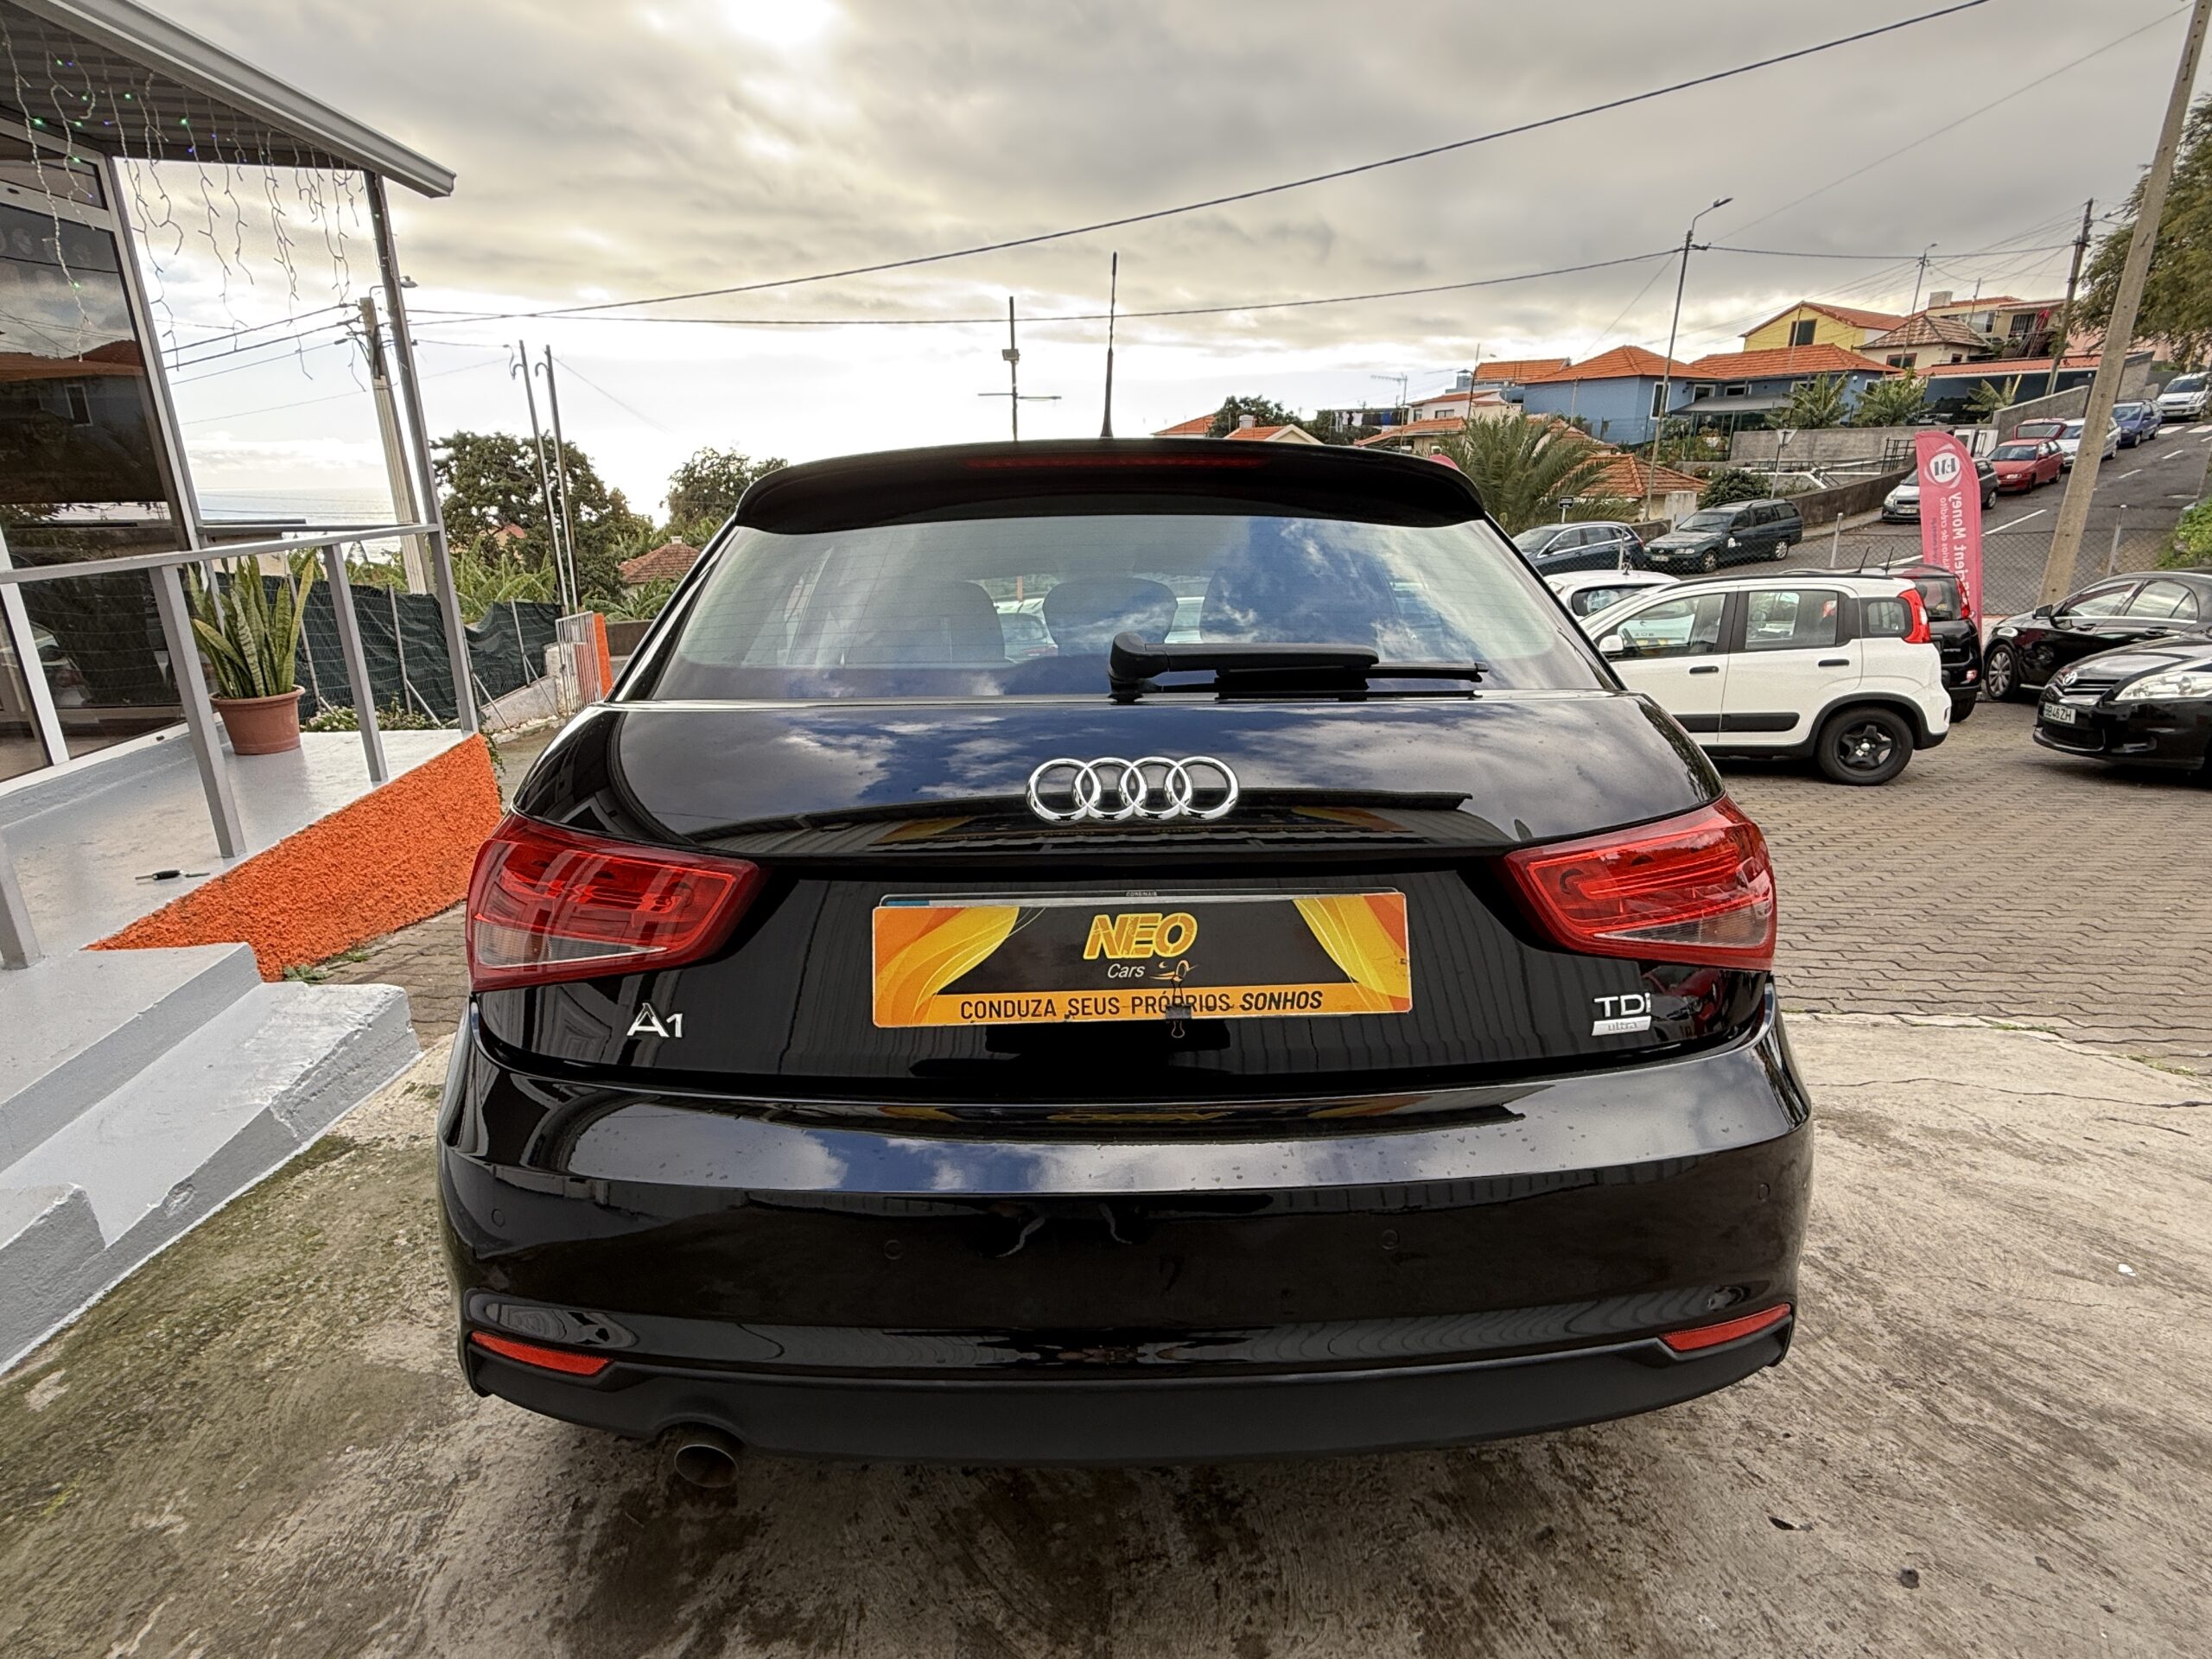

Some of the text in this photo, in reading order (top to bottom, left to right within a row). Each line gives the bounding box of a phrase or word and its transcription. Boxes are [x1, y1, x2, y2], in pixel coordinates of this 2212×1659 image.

[1083, 912, 1198, 959] NEO
[1107, 963, 1146, 978] Cars
[626, 1002, 683, 1038] A1
[960, 998, 1057, 1020] CONDUZA
[1067, 996, 1121, 1016] SEUS
[1239, 990, 1324, 1011] SONHOS
[1608, 1021, 1637, 1032] ultra
